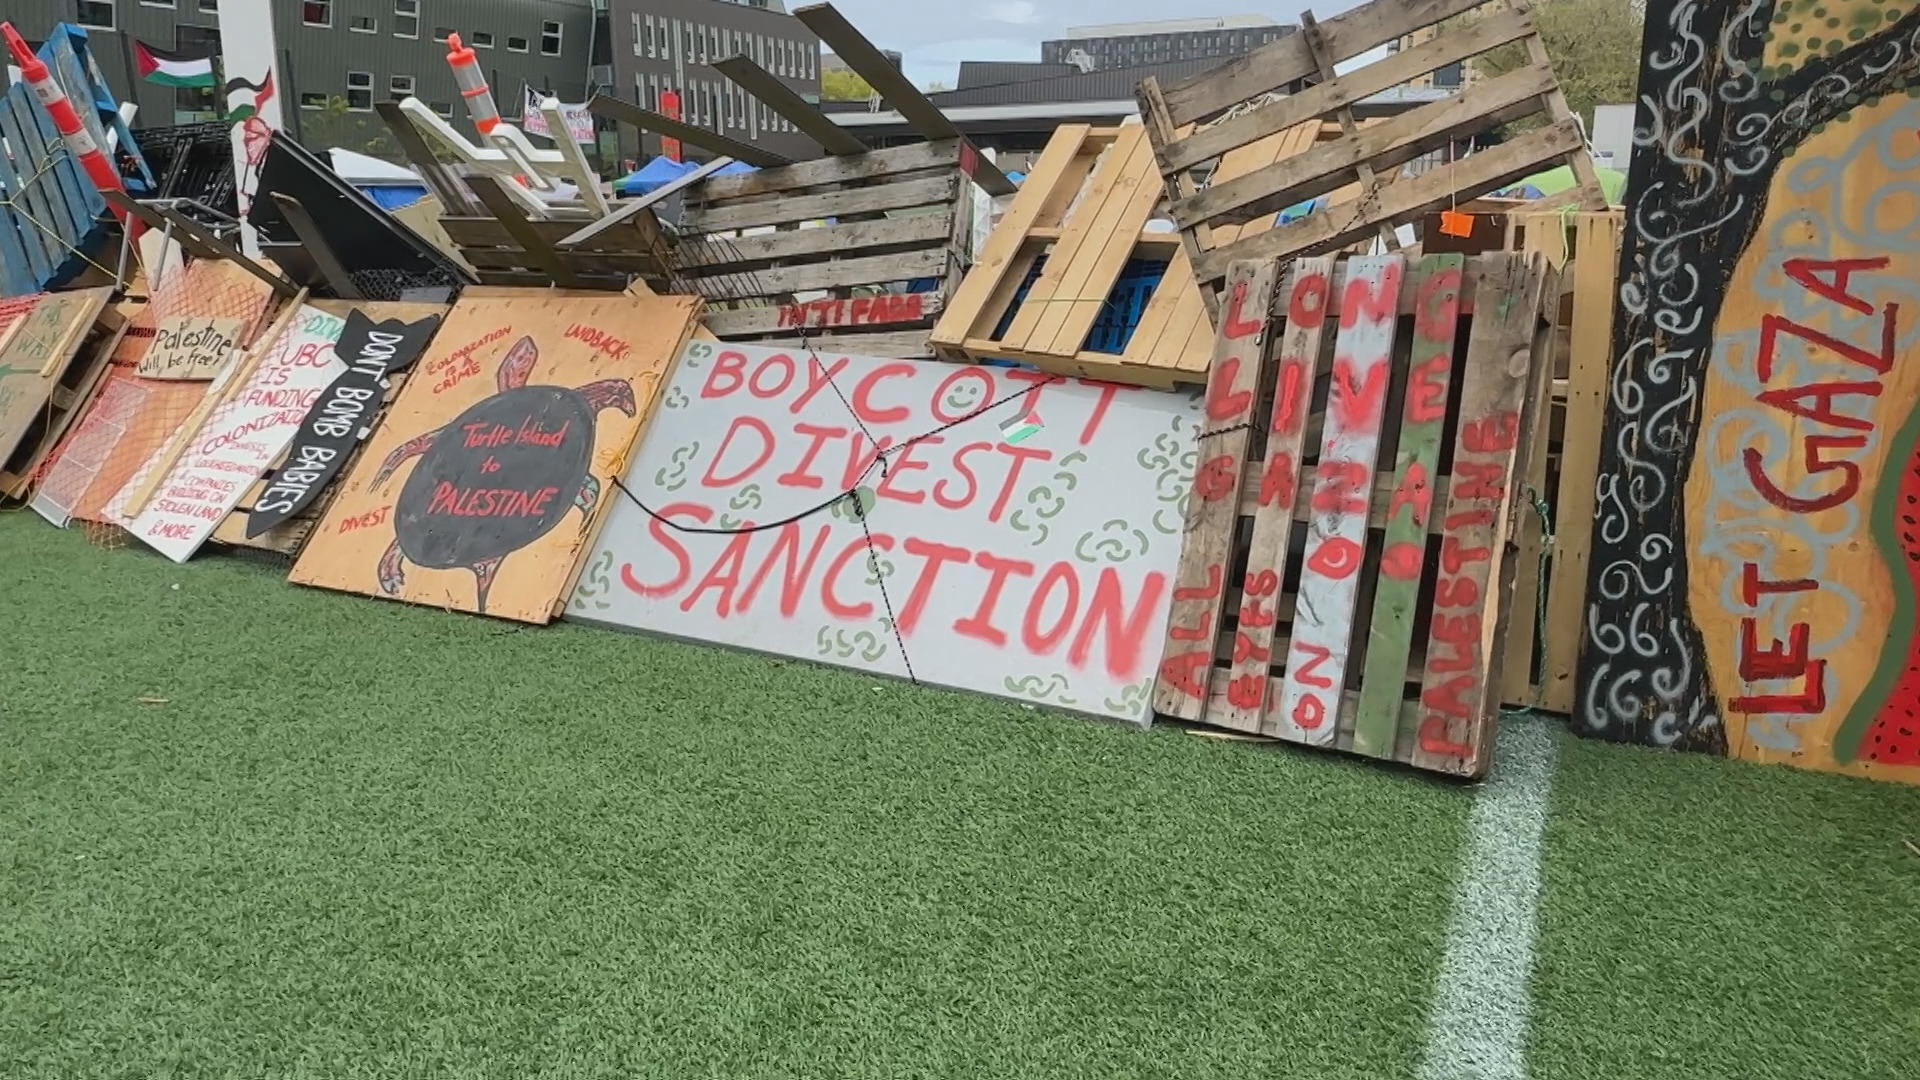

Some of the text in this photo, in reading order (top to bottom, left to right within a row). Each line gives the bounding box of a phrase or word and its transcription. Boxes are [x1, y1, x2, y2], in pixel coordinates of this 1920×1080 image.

[1222, 263, 1461, 341] LONG
[151, 319, 233, 356] Palestine
[304, 315, 343, 341] DIV
[564, 323, 631, 361] LANDBACK
[167, 351, 184, 369] be
[280, 343, 336, 368] UBC
[260, 367, 292, 386] IS
[432, 361, 481, 394] CRIME
[1204, 352, 1450, 433] LIVE
[243, 388, 322, 408] FUNDING
[313, 386, 375, 438] BOMB
[700, 349, 1148, 446] BOYCOTT
[461, 414, 571, 448] Turtle Island
[255, 444, 338, 514] BABIES
[479, 455, 501, 474] to
[701, 416, 1053, 524] DIVEST
[426, 480, 560, 518] PALESTINE
[1728, 256, 1901, 716] LET GAZA
[153, 499, 223, 522] STOLEN LAND
[159, 524, 197, 540] MORE
[620, 501, 1167, 686] SANCTION
[1418, 409, 1519, 760] PALESTINE
[1161, 562, 1222, 700] ALL
[1226, 567, 1279, 712] EYES
[1291, 641, 1333, 732] ON
